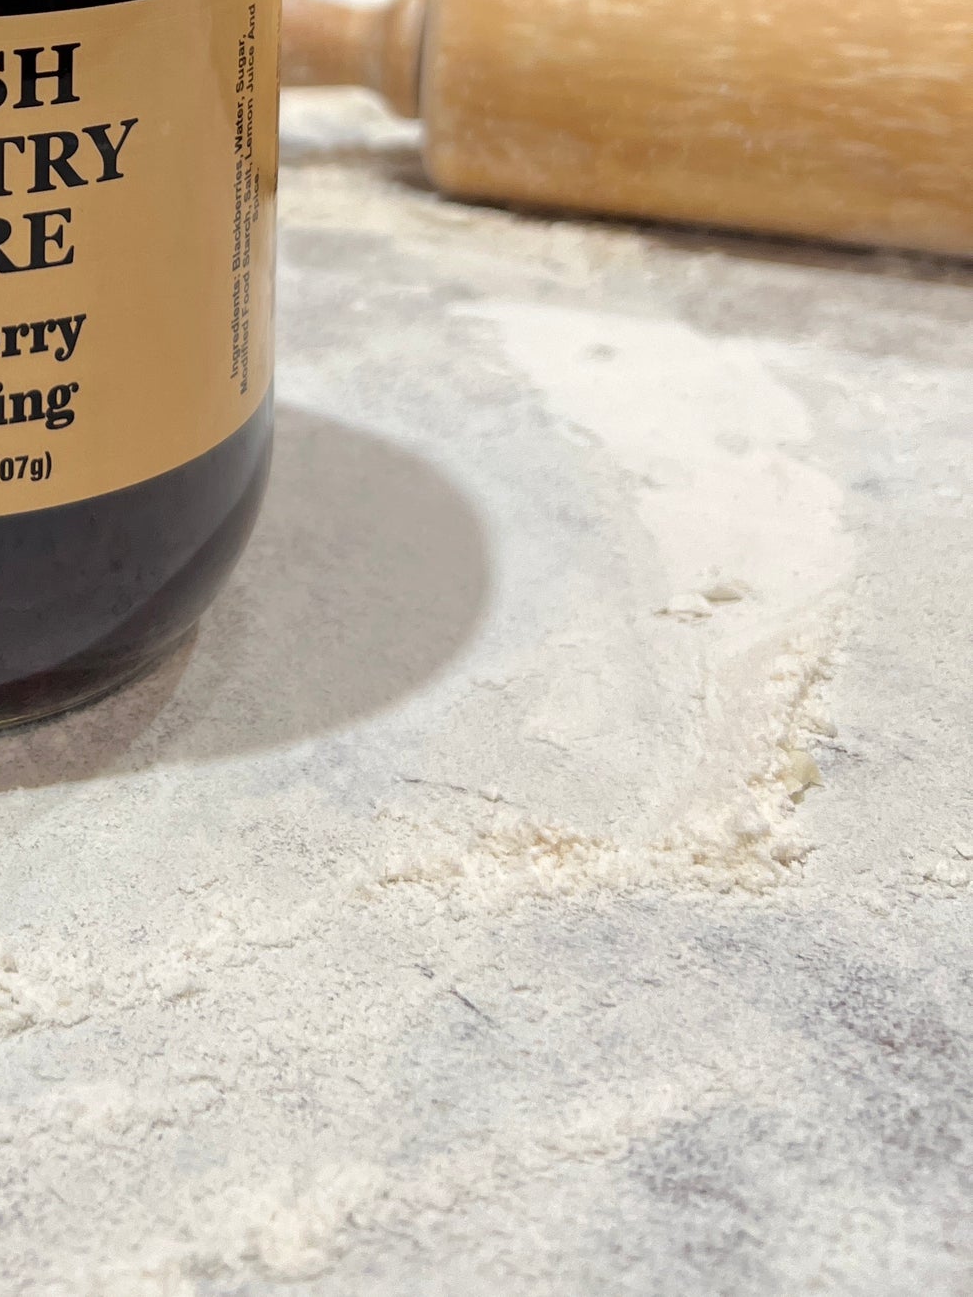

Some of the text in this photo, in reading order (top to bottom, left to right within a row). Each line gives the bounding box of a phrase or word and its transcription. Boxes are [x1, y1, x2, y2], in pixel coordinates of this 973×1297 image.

[231, 34, 247, 379] Ingredients: Blackberries, Water, Sugar,
[240, 3, 256, 395] Modified Food Starch, Salt, Lemon Juice And
